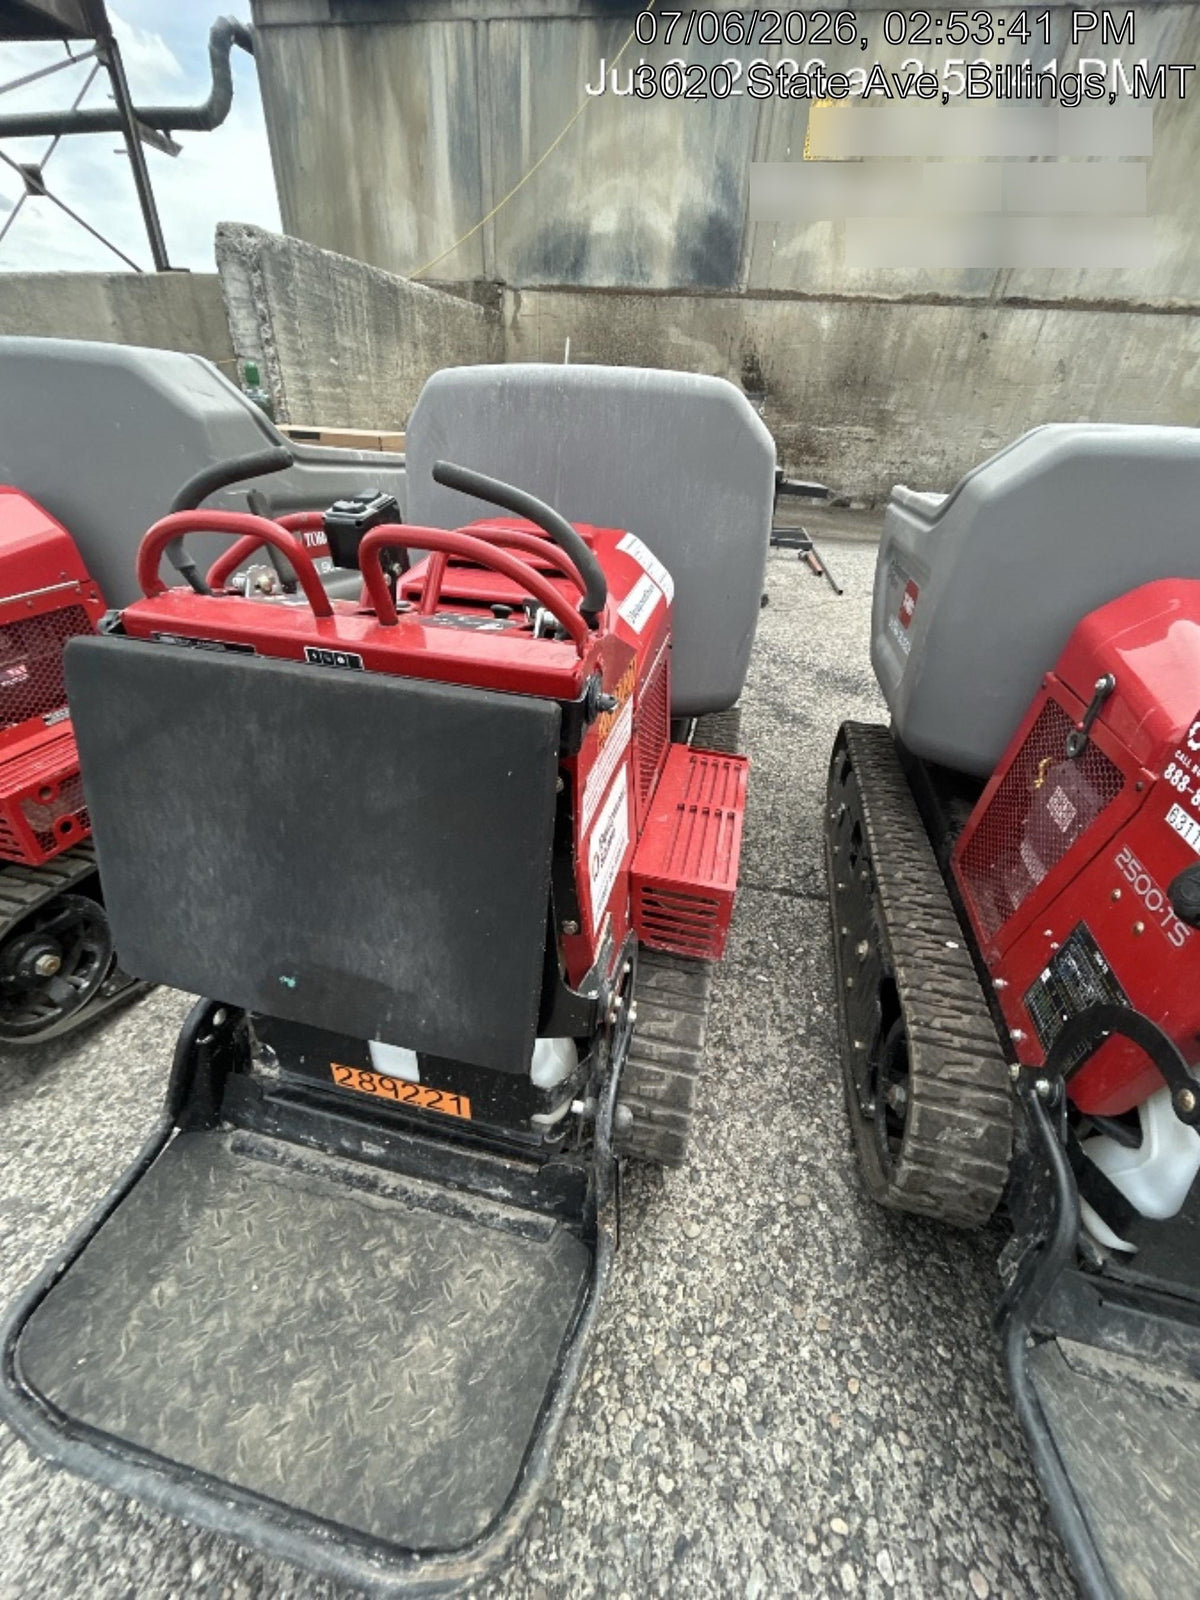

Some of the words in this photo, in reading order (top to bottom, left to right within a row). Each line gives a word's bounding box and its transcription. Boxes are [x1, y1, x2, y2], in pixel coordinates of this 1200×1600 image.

[303, 530, 328, 548] TOR
[1163, 761, 1200, 811] 888-8
[1167, 806, 1200, 853] 6311
[335, 1066, 463, 1115] 289221
